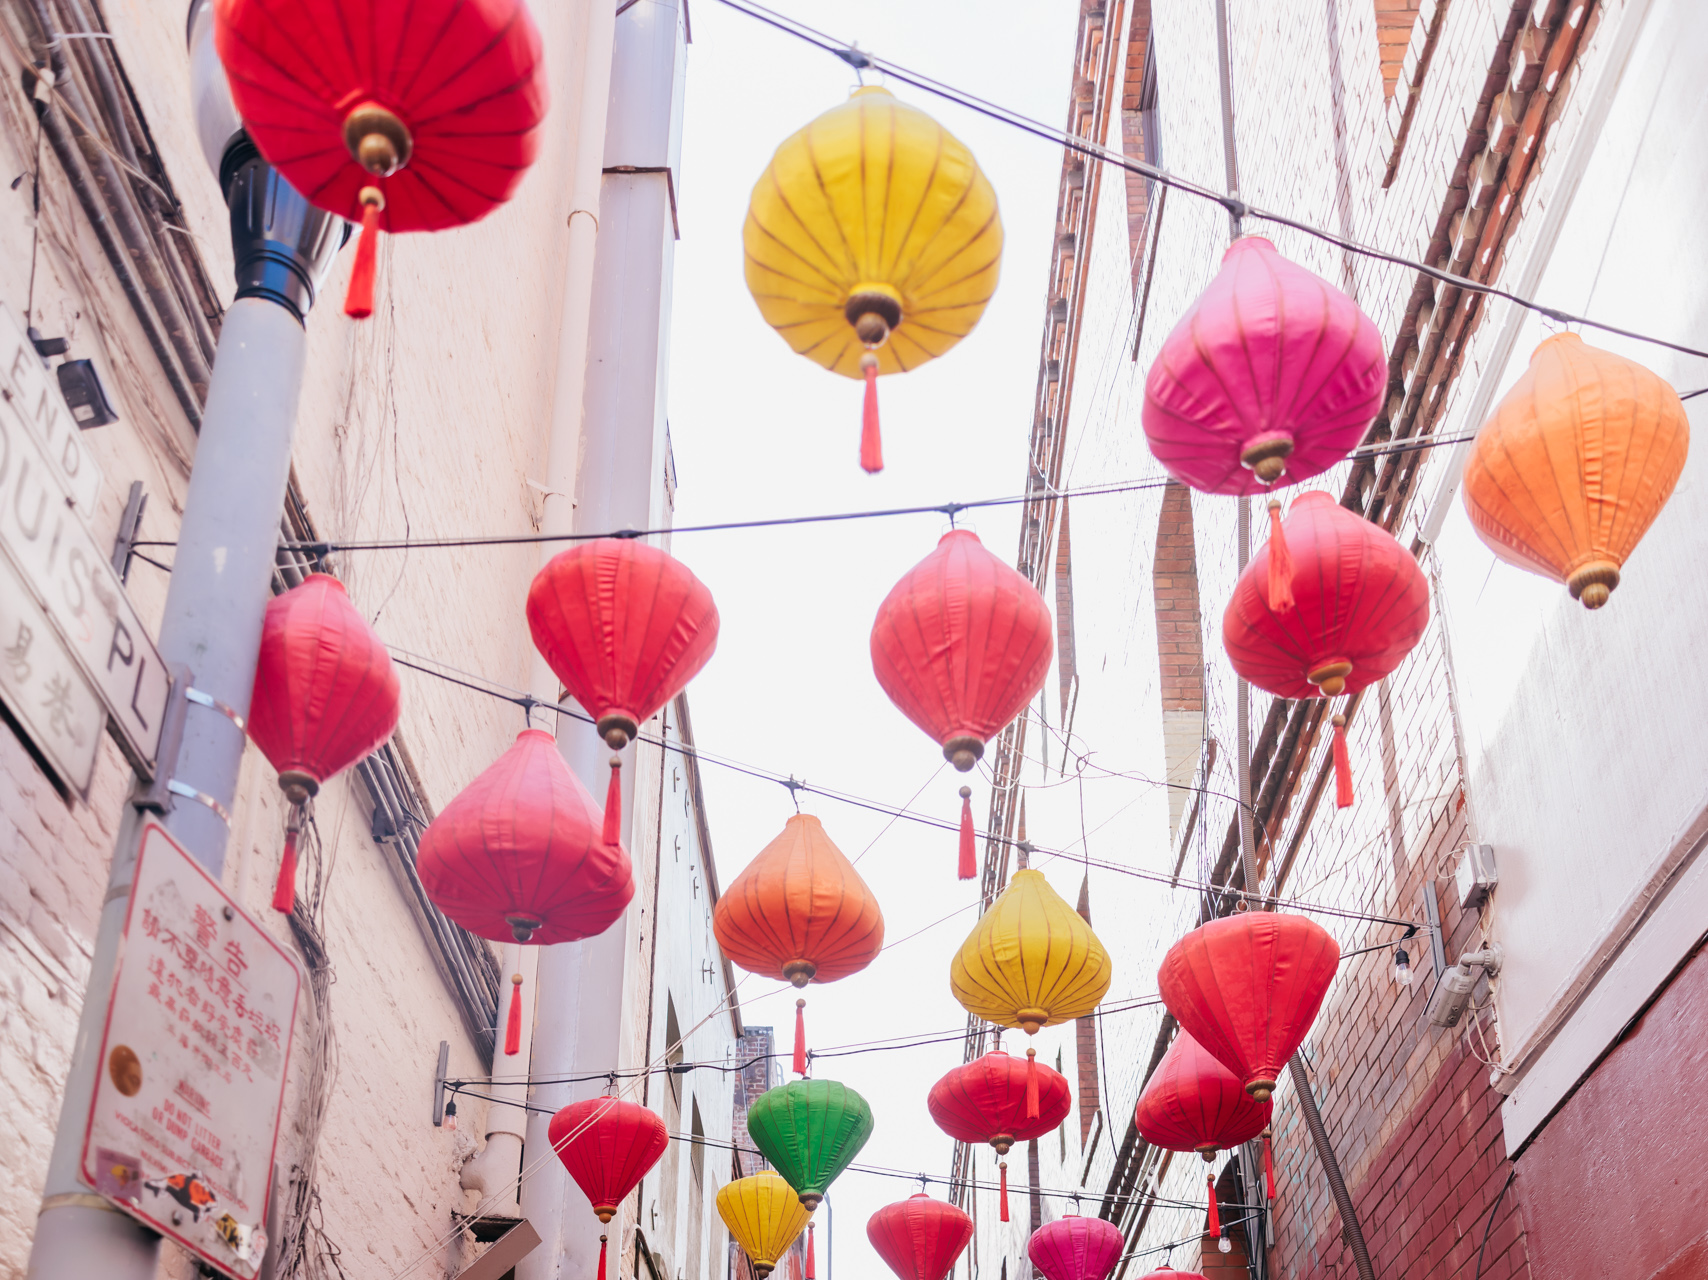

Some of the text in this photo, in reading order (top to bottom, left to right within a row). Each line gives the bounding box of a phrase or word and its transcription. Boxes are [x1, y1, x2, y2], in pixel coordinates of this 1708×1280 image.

[10, 344, 80, 478] END
[107, 616, 149, 732] PL
[193, 904, 248, 977] 警告
[115, 1111, 160, 1146] VIOLATORS
[152, 1106, 223, 1170] OR DUMP GARBAGE
[164, 1099, 221, 1151] DO NOT LITTER
